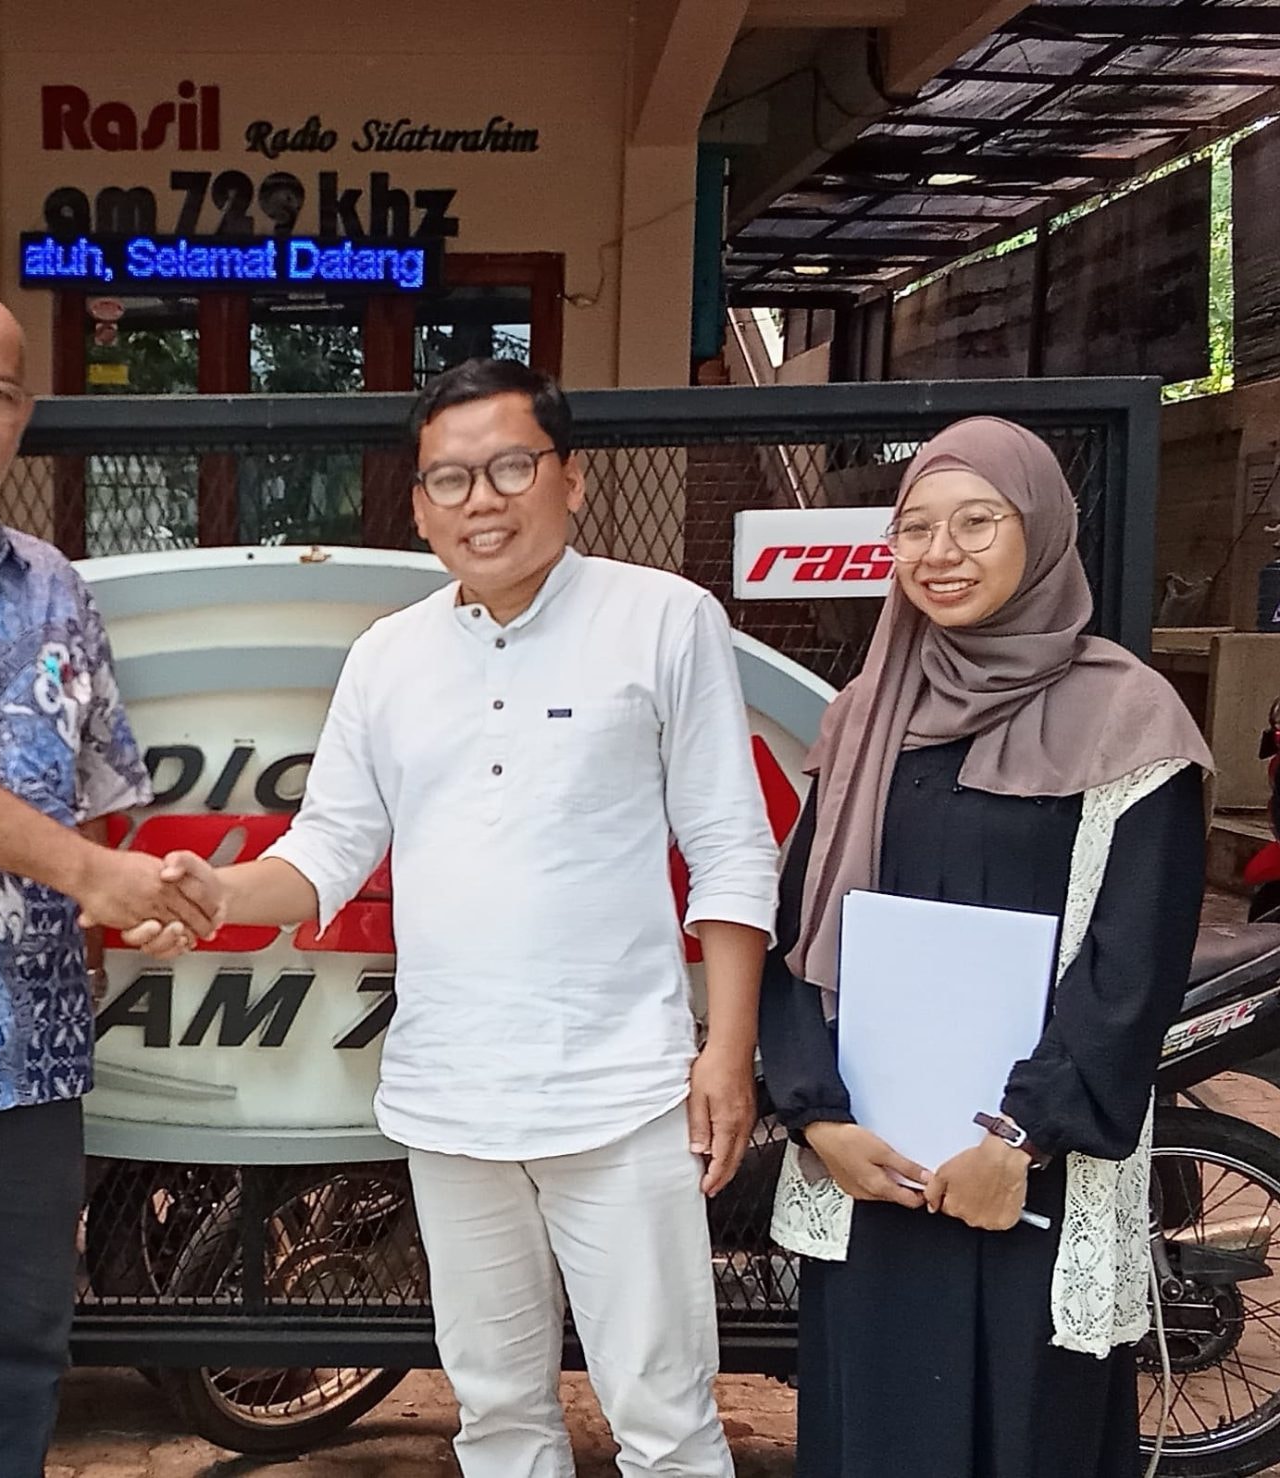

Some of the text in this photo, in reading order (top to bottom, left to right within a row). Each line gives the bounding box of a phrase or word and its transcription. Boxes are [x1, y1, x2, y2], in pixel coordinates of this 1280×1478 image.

[41, 80, 540, 159] Rasil Radio Silaturahim
[170, 171, 306, 236] 729
[318, 171, 460, 238] khz
[127, 238, 278, 280] Selamat
[288, 240, 425, 288] Datang
[745, 543, 894, 582] ras
[143, 744, 320, 812] DIO
[94, 972, 316, 1049] AM
